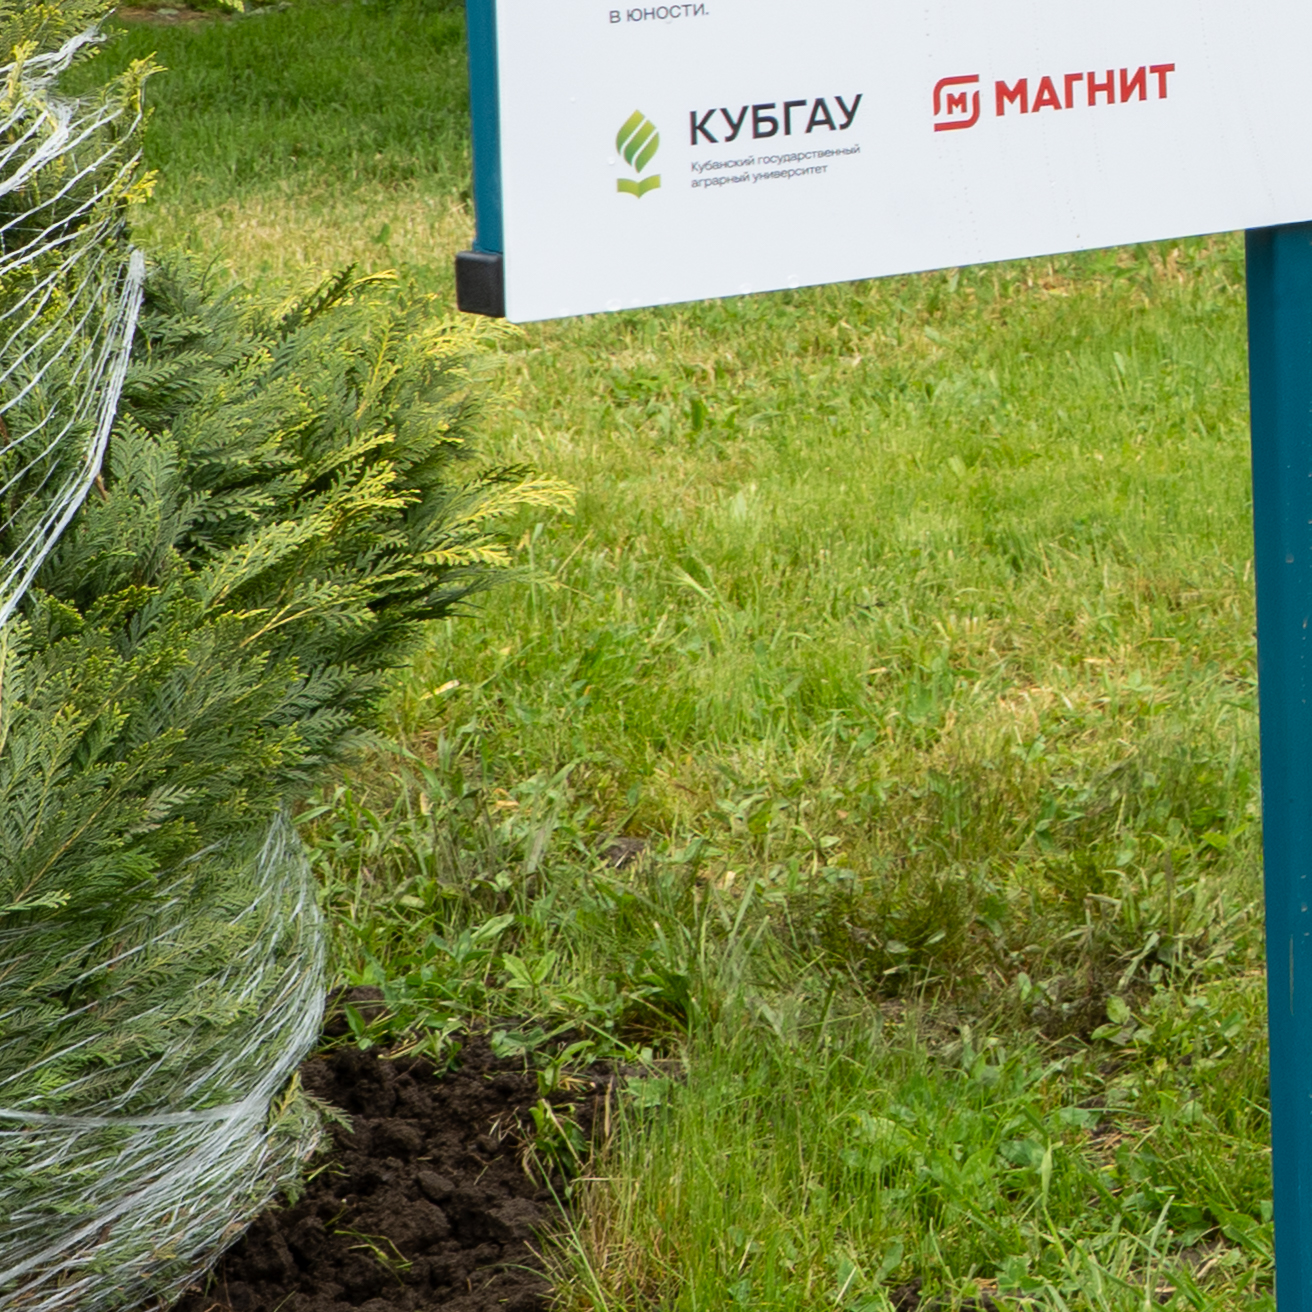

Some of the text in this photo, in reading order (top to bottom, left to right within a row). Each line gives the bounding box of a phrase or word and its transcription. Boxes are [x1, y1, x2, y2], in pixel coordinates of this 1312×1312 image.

[609, 2, 709, 24] в юности.
[995, 63, 1175, 116] МАГНИТ
[689, 93, 863, 146] КУБГАУ
[691, 144, 861, 174] Кубанский государственный
[691, 164, 828, 189] аграрный университет
